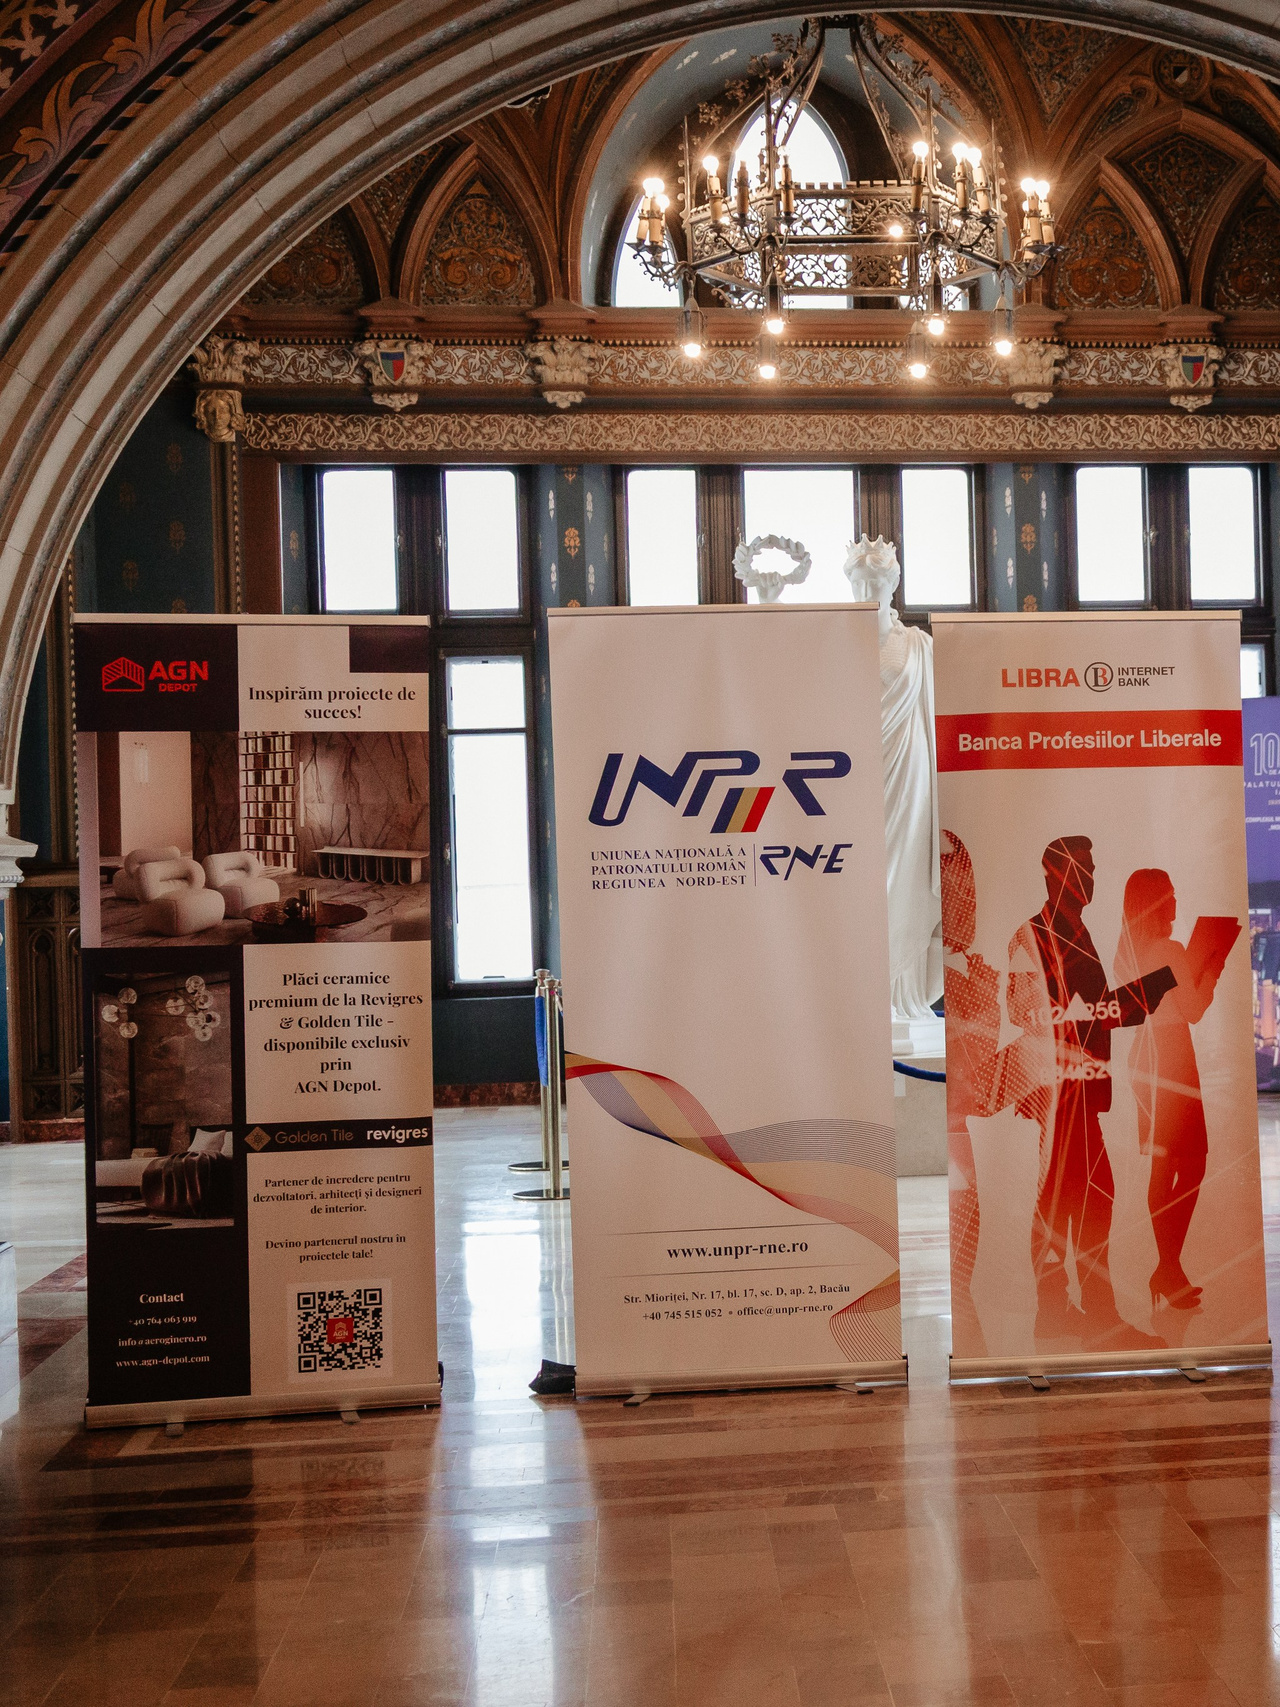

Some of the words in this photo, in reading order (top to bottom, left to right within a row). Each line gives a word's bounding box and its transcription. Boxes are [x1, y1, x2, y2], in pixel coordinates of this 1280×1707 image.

[148, 661, 209, 680] AGN
[1002, 668, 1080, 688] LIBRA
[1118, 666, 1175, 675] INTERNET
[158, 683, 197, 692] DEPOT
[1118, 677, 1150, 687] BANK
[249, 686, 322, 702] Inspirăm
[327, 686, 393, 702] proiecte
[397, 687, 415, 701] de
[304, 706, 361, 719] succes!
[959, 734, 1022, 752] Banca
[1029, 730, 1134, 749] Profesiilor
[1140, 729, 1222, 748] Liberale
[591, 849, 650, 861] UNIUNEA
[655, 845, 732, 860] NAȚIONALĂ
[738, 847, 746, 856] A
[592, 862, 692, 876] PATRONATULUI
[697, 858, 746, 872] ROMÂN
[592, 878, 666, 890] REGIUNEA
[676, 875, 747, 887] NORD-EST
[283, 973, 318, 986] Plăci
[323, 972, 390, 985] ceramice
[249, 995, 317, 1011] premium
[322, 994, 339, 1006] de
[344, 994, 356, 1006] la
[361, 993, 422, 1007] Revigres
[280, 1017, 294, 1029] &
[298, 1016, 350, 1028] Golden
[355, 1015, 383, 1026] Tile
[264, 1037, 347, 1053] disponibile
[352, 1036, 410, 1048] exclusiv
[320, 1058, 351, 1073] prin
[294, 1080, 328, 1093] AGN
[333, 1080, 381, 1094] Depot.
[275, 1131, 327, 1143] Golden
[331, 1129, 353, 1141] Tile
[367, 1126, 428, 1143] revigres
[265, 1178, 309, 1187] Partener
[312, 1176, 323, 1185] de
[326, 1175, 374, 1184] încredere
[377, 1175, 410, 1184] pentru
[375, 1187, 422, 1198] designeri
[310, 1206, 322, 1214] de
[325, 1205, 366, 1213] interior.
[265, 1240, 301, 1249] Devino
[304, 1236, 357, 1248] partenerul
[360, 1236, 393, 1244] nostru
[396, 1234, 406, 1242] în
[300, 1252, 349, 1263] proiectele
[352, 1249, 373, 1259] tale!
[667, 1242, 808, 1259] www.unpr-rne.ro
[140, 1293, 184, 1303] Contact
[624, 1294, 641, 1304] Str.
[691, 1291, 706, 1300] Nr.
[710, 1290, 724, 1300] 17,
[727, 1289, 739, 1298] bl.
[743, 1289, 757, 1298] 17,
[790, 1287, 804, 1297] ap.
[819, 1284, 850, 1294] Bacău
[643, 1312, 661, 1321] +40
[664, 1310, 681, 1320] 745
[685, 1310, 701, 1319] 515
[705, 1309, 722, 1318] 052
[737, 1303, 833, 1317] office@unpr-rne.ro
